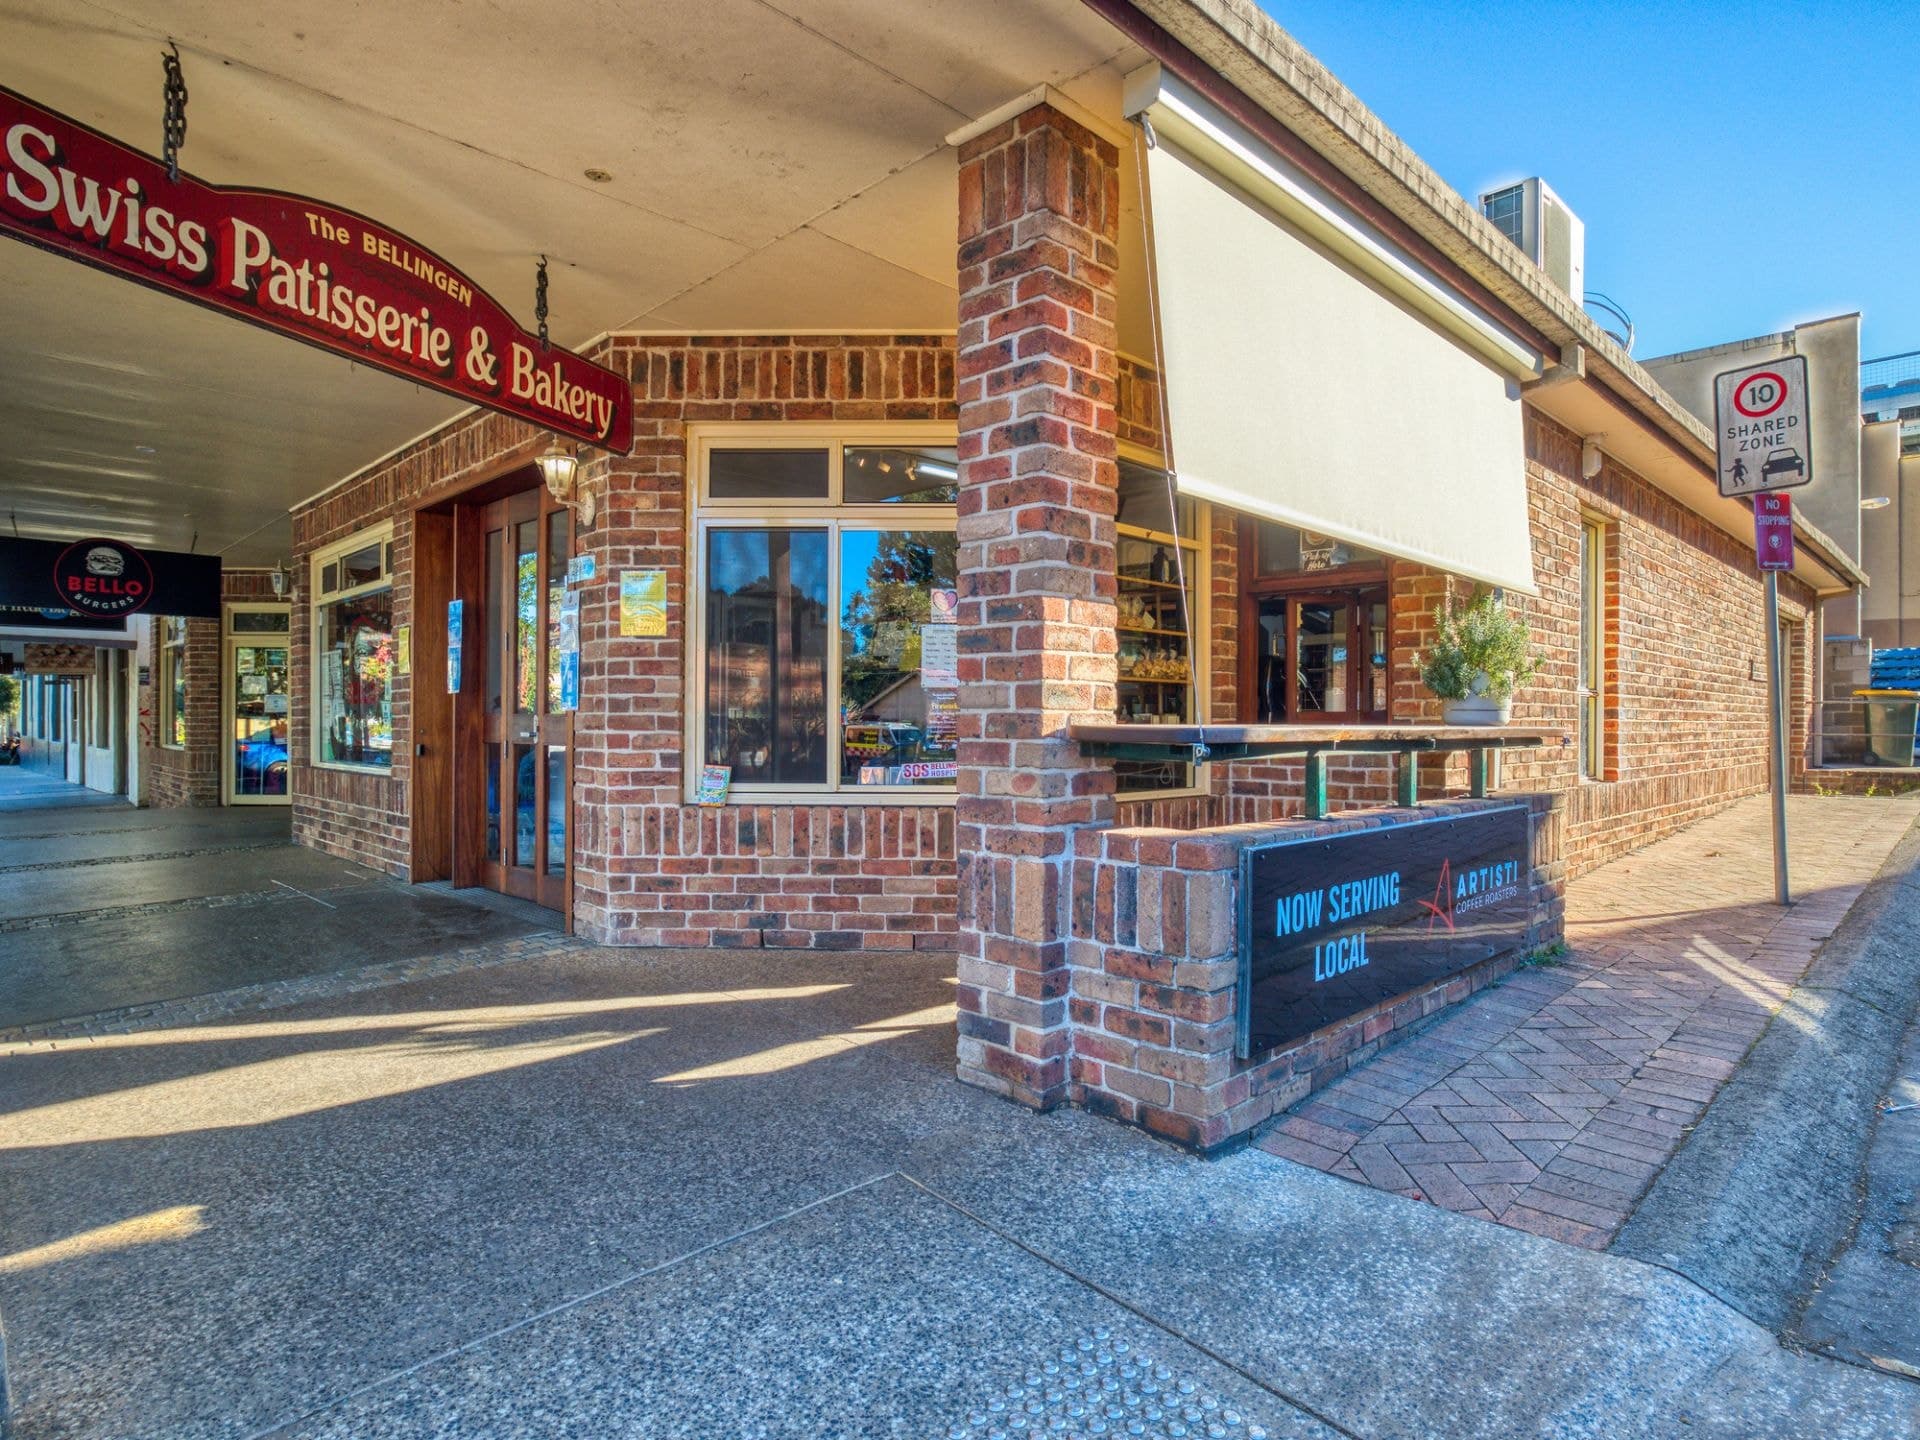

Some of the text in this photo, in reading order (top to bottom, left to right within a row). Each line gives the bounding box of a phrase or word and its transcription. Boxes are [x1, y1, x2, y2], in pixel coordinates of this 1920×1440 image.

[305, 212, 473, 308] The BELLINGEN
[5, 123, 614, 440] Swiss Patisserie & Bakery
[1749, 383, 1775, 407] 10
[1727, 415, 1798, 439] SHARED
[1739, 432, 1786, 452] ZONE
[1765, 499, 1780, 510] NO
[1757, 514, 1790, 526] STOPPING
[67, 575, 143, 596] BELLO
[74, 593, 135, 609] BURGERS
[903, 763, 929, 779] SOS
[931, 762, 958, 770] BELLING
[931, 769, 958, 777] HOSPIT
[1456, 860, 1518, 898] ARTISTI
[1276, 871, 1400, 937] NOW SERVING
[1456, 885, 1518, 914] COFFEE ROASTERS
[1314, 931, 1369, 982] LOCAL
